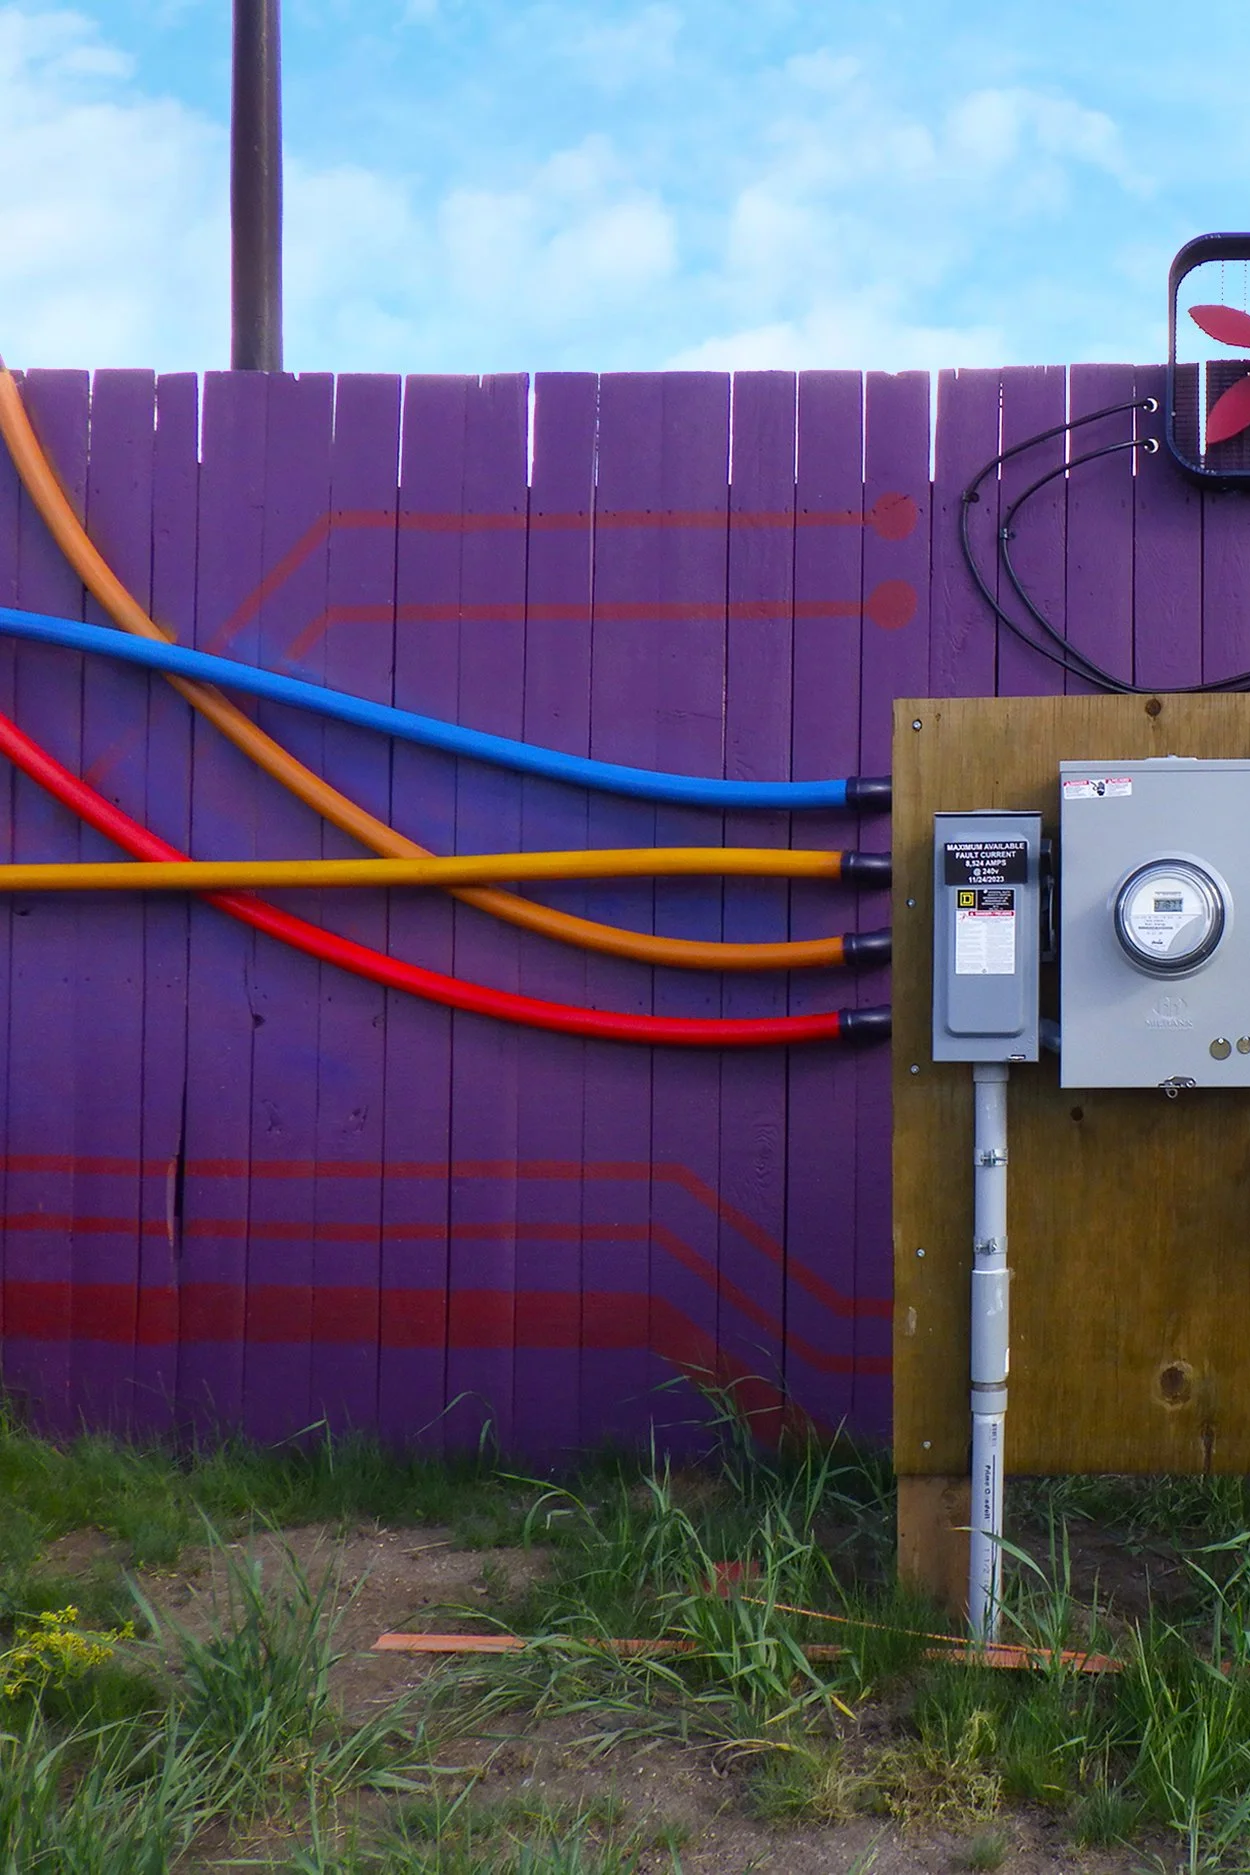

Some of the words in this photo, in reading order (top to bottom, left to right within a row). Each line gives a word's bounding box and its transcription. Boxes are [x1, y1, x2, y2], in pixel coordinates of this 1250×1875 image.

[973, 868, 981, 876] @
[983, 1464, 992, 1486] Prime
[984, 1488, 992, 1520] Cnduit
